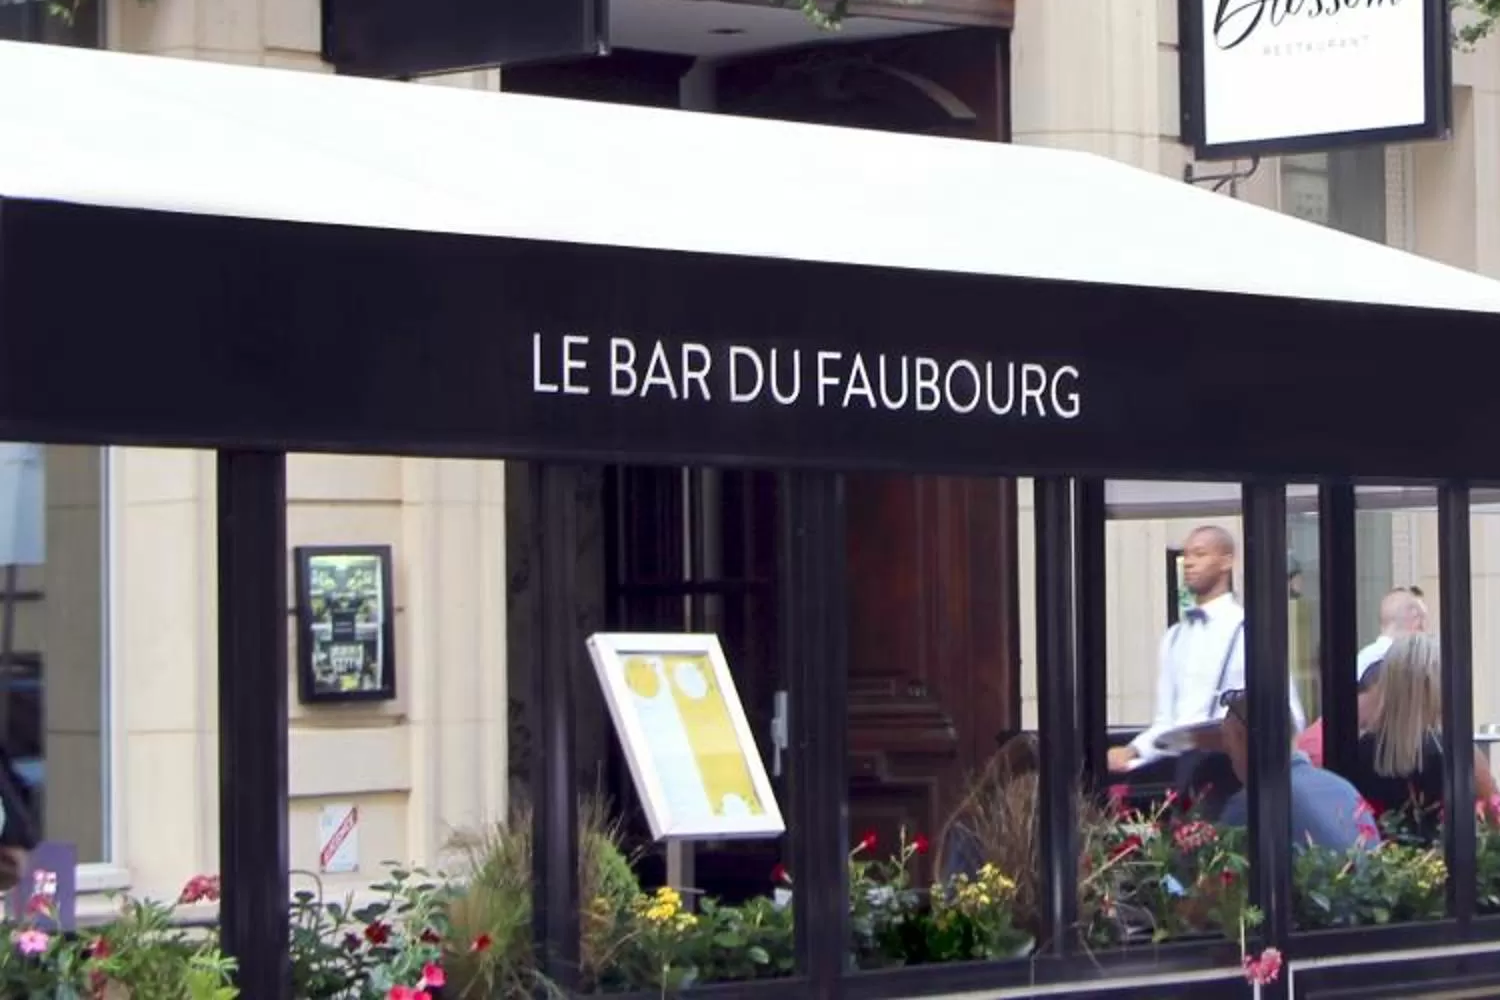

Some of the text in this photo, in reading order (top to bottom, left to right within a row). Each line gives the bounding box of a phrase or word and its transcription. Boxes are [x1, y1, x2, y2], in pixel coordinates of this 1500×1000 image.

[533, 332, 1081, 419] LE BAR DU FAUBOURG
